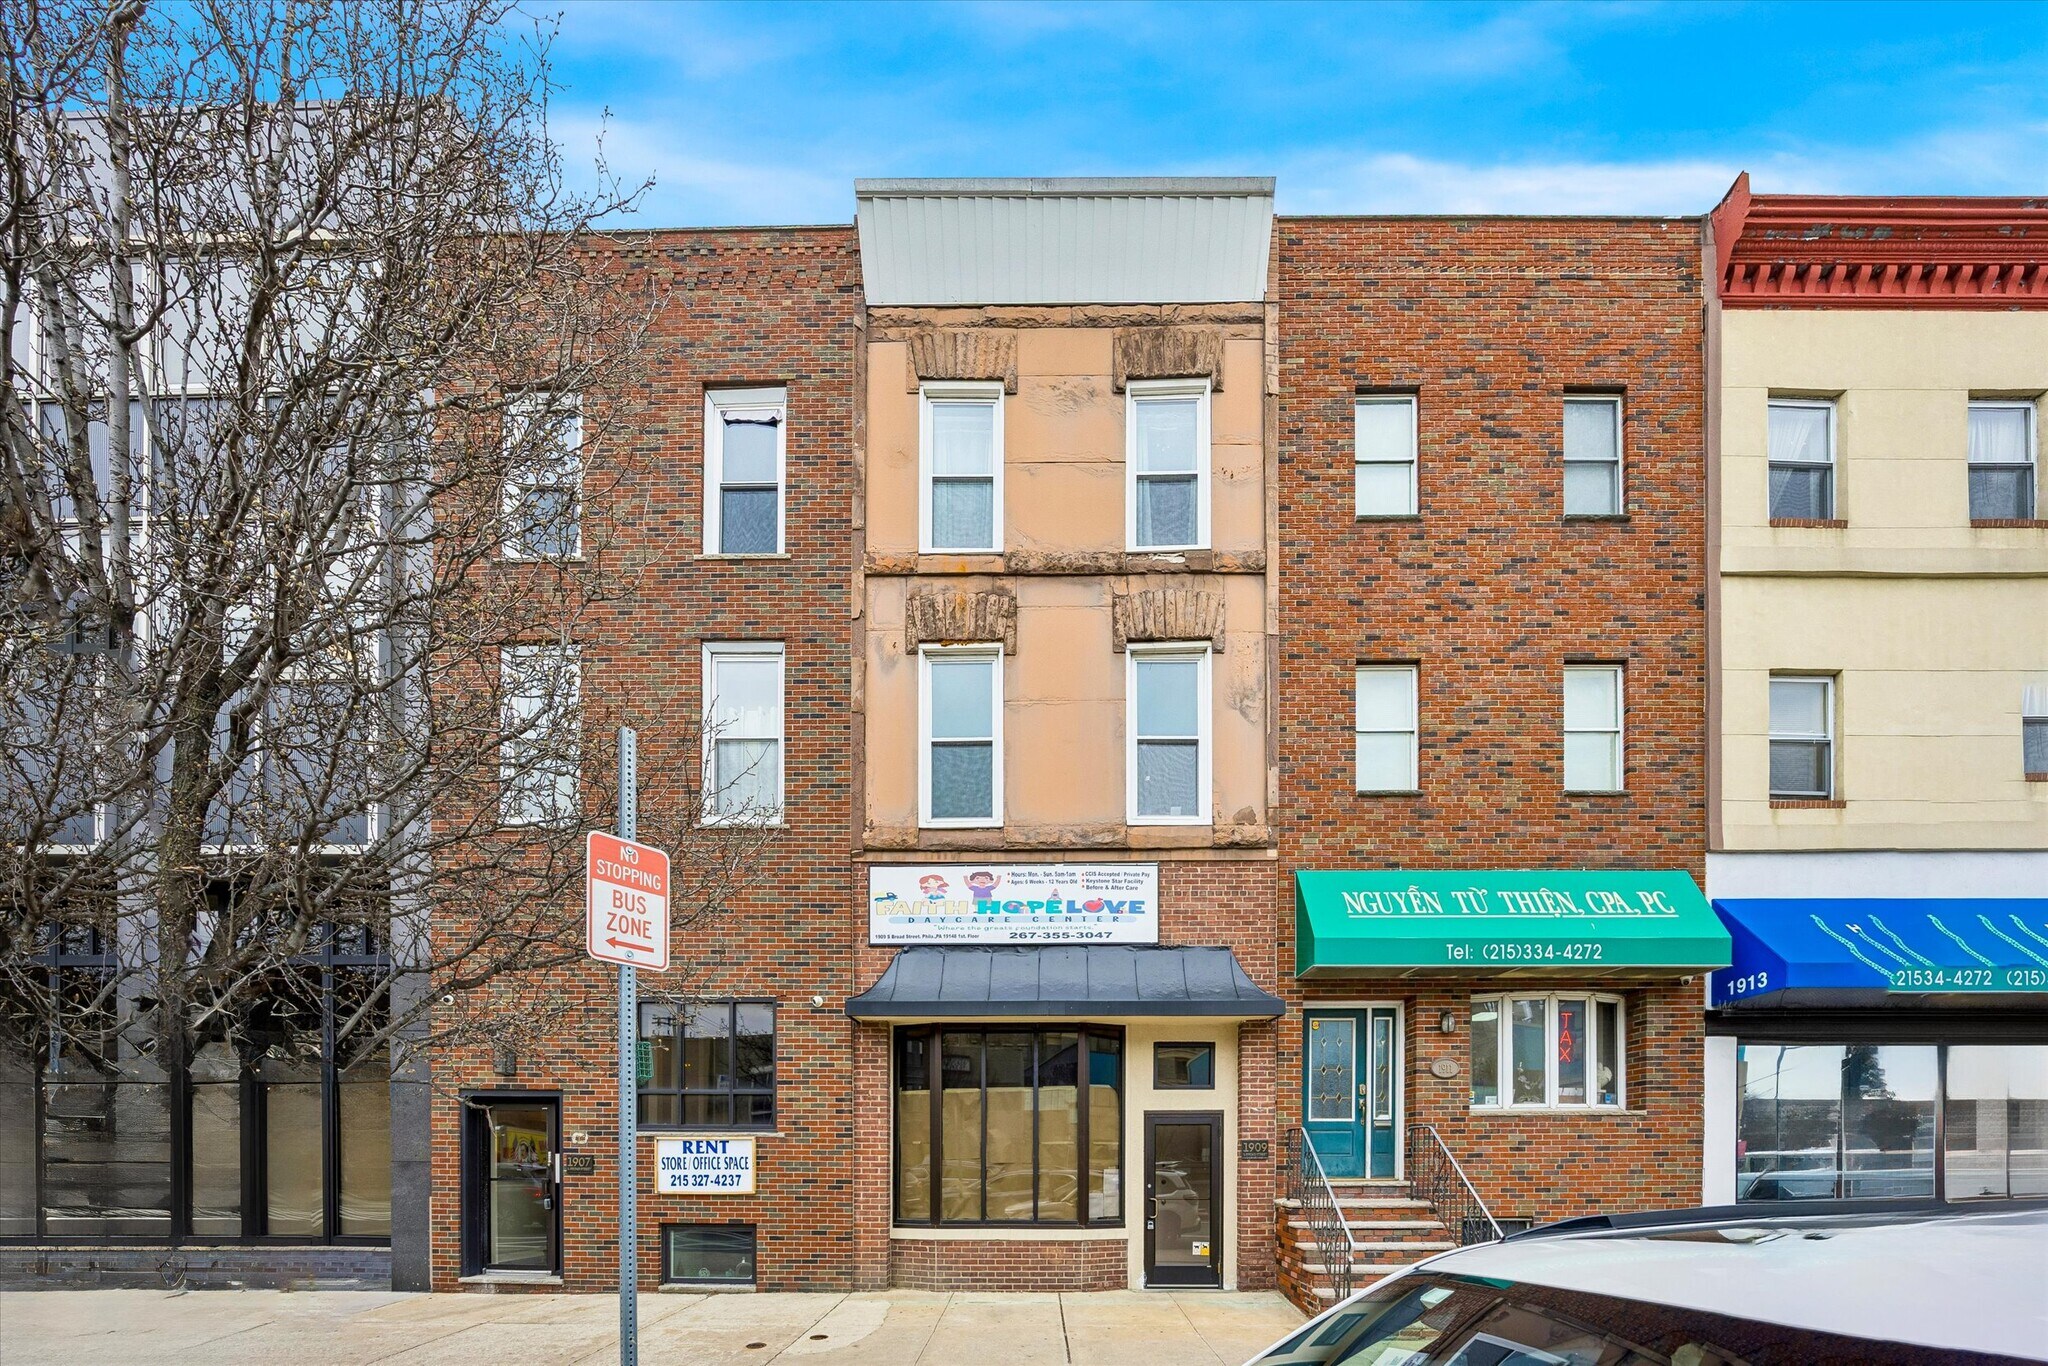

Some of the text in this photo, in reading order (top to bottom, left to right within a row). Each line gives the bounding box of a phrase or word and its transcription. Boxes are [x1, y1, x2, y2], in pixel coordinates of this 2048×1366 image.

[620, 846, 639, 865] NO
[596, 859, 661, 890] STOPPING
[612, 889, 647, 915] BUS
[876, 899, 1146, 915] FAITH HOPE LOVE
[1341, 884, 1444, 914] NGUYỄN
[1585, 890, 1642, 916] CPA,
[1636, 890, 1676, 914] PC
[606, 912, 652, 940] ZONE
[1009, 931, 1113, 939] 267-355-3047
[1446, 943, 1602, 960] Tel: (215)334-4272
[1727, 971, 1768, 995] 1913
[1560, 1012, 1573, 1063] TAX
[682, 1140, 729, 1154] RENT
[1243, 1142, 1268, 1152] 1909
[567, 1156, 591, 1167] 1907
[724, 1156, 749, 1170] SPACE
[670, 1174, 742, 1187] 215 327-4237
